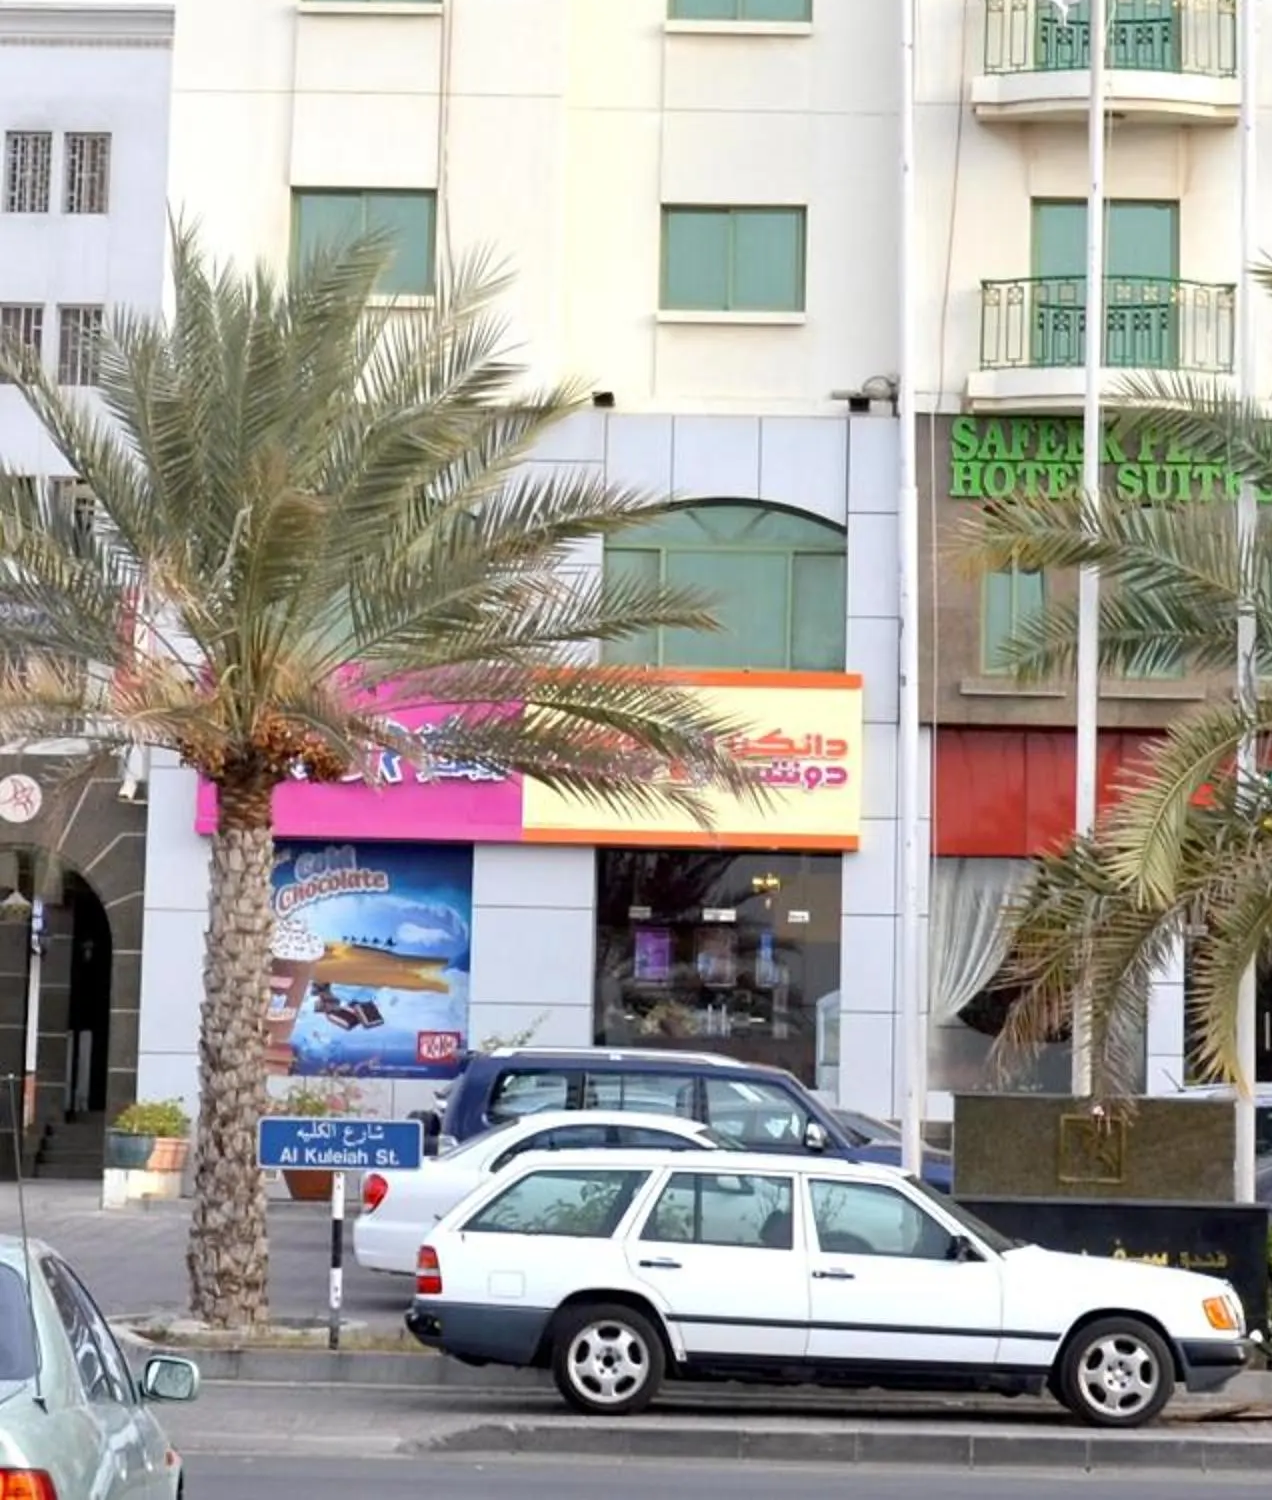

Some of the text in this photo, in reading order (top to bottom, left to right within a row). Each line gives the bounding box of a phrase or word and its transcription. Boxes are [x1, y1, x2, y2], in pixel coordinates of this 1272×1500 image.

[950, 461, 1085, 500] HOTE
[343, 1123, 385, 1147] شارع
[280, 1147, 400, 1166] Al Kuleiah St.
